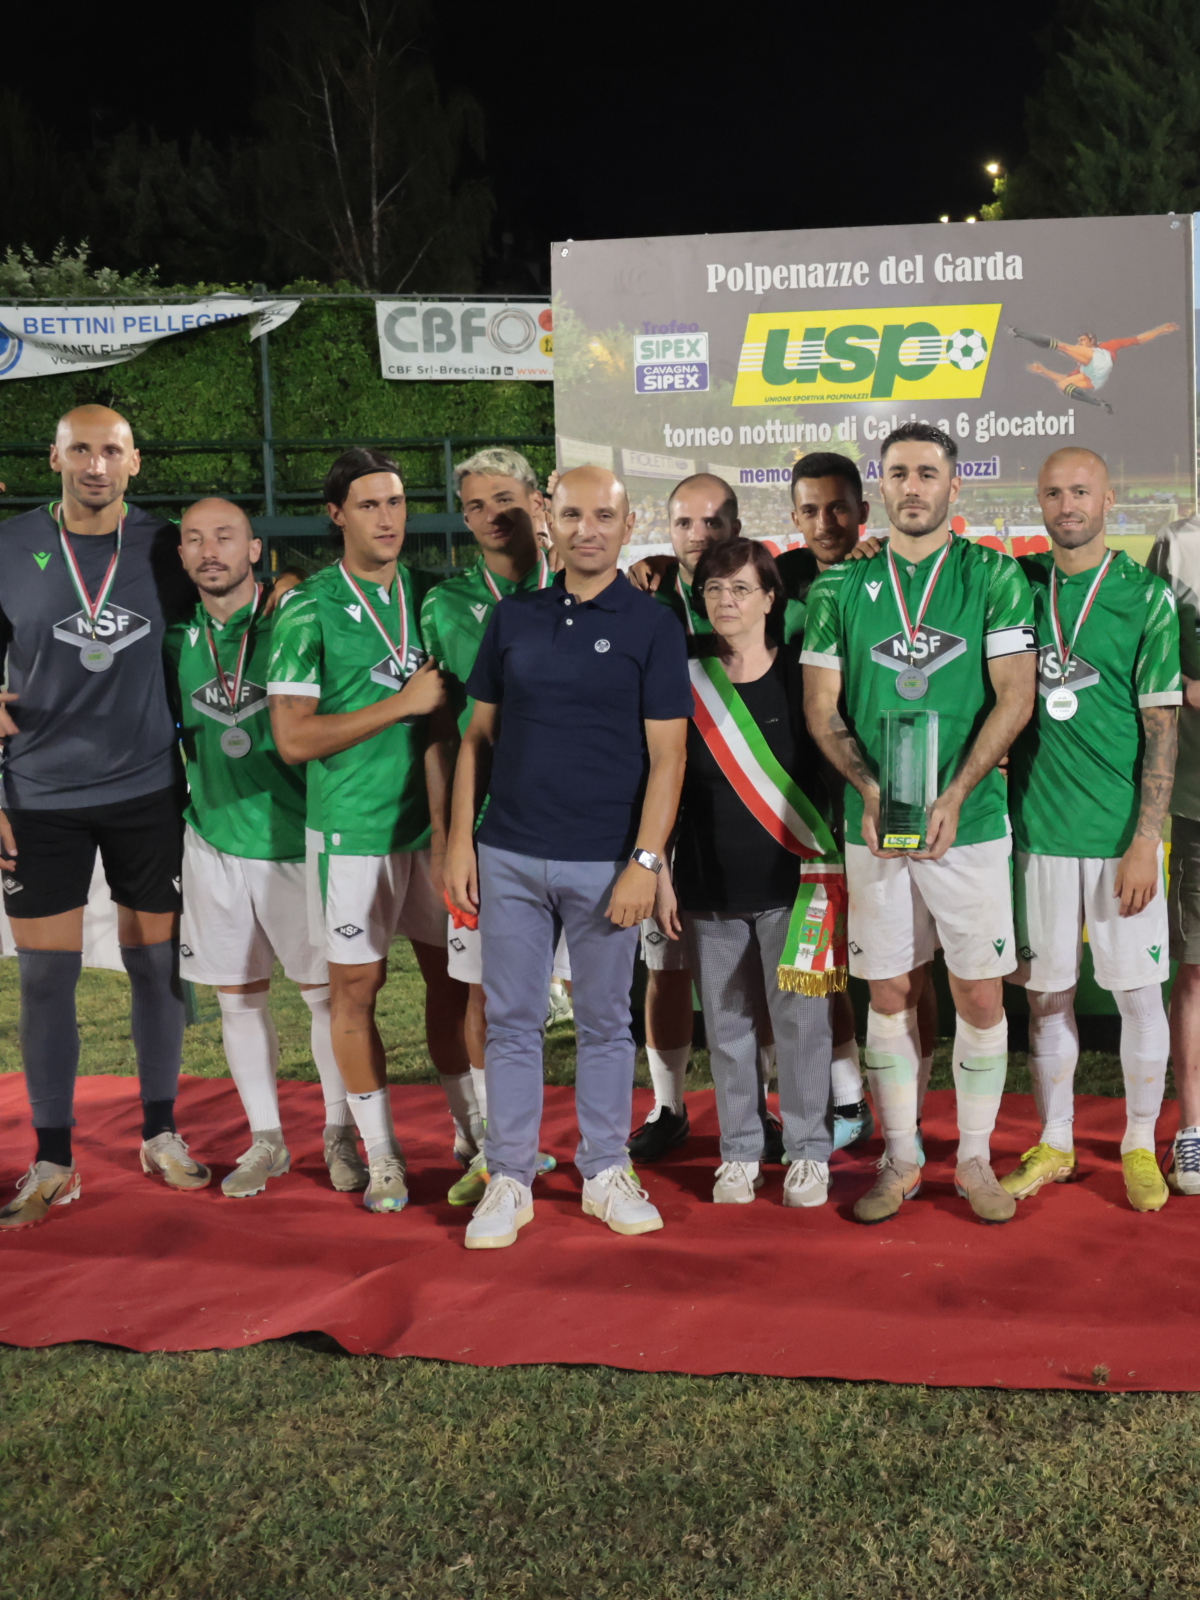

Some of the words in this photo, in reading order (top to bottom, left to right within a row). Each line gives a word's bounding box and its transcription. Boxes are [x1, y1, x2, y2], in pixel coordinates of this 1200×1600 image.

[706, 261, 870, 294] Polpenazze
[879, 255, 925, 285] del
[934, 251, 1024, 283] Garda
[23, 317, 115, 334] BETTINI
[642, 320, 699, 334] Trofeo
[640, 338, 702, 360] SIPEX
[761, 321, 942, 398] usp
[388, 365, 412, 375] CBF
[417, 365, 490, 375] Srl-Brescia:
[643, 364, 699, 375] CAVAGNA
[643, 374, 699, 390] SIPEX
[826, 393, 869, 401] POLPENAZZE
[663, 423, 734, 448] torneo
[739, 419, 832, 445] notturno
[837, 415, 858, 441] di
[956, 412, 970, 438] 6
[975, 408, 1076, 443] giocatori
[892, 631, 941, 659] NSF
[340, 925, 359, 936] NSF
